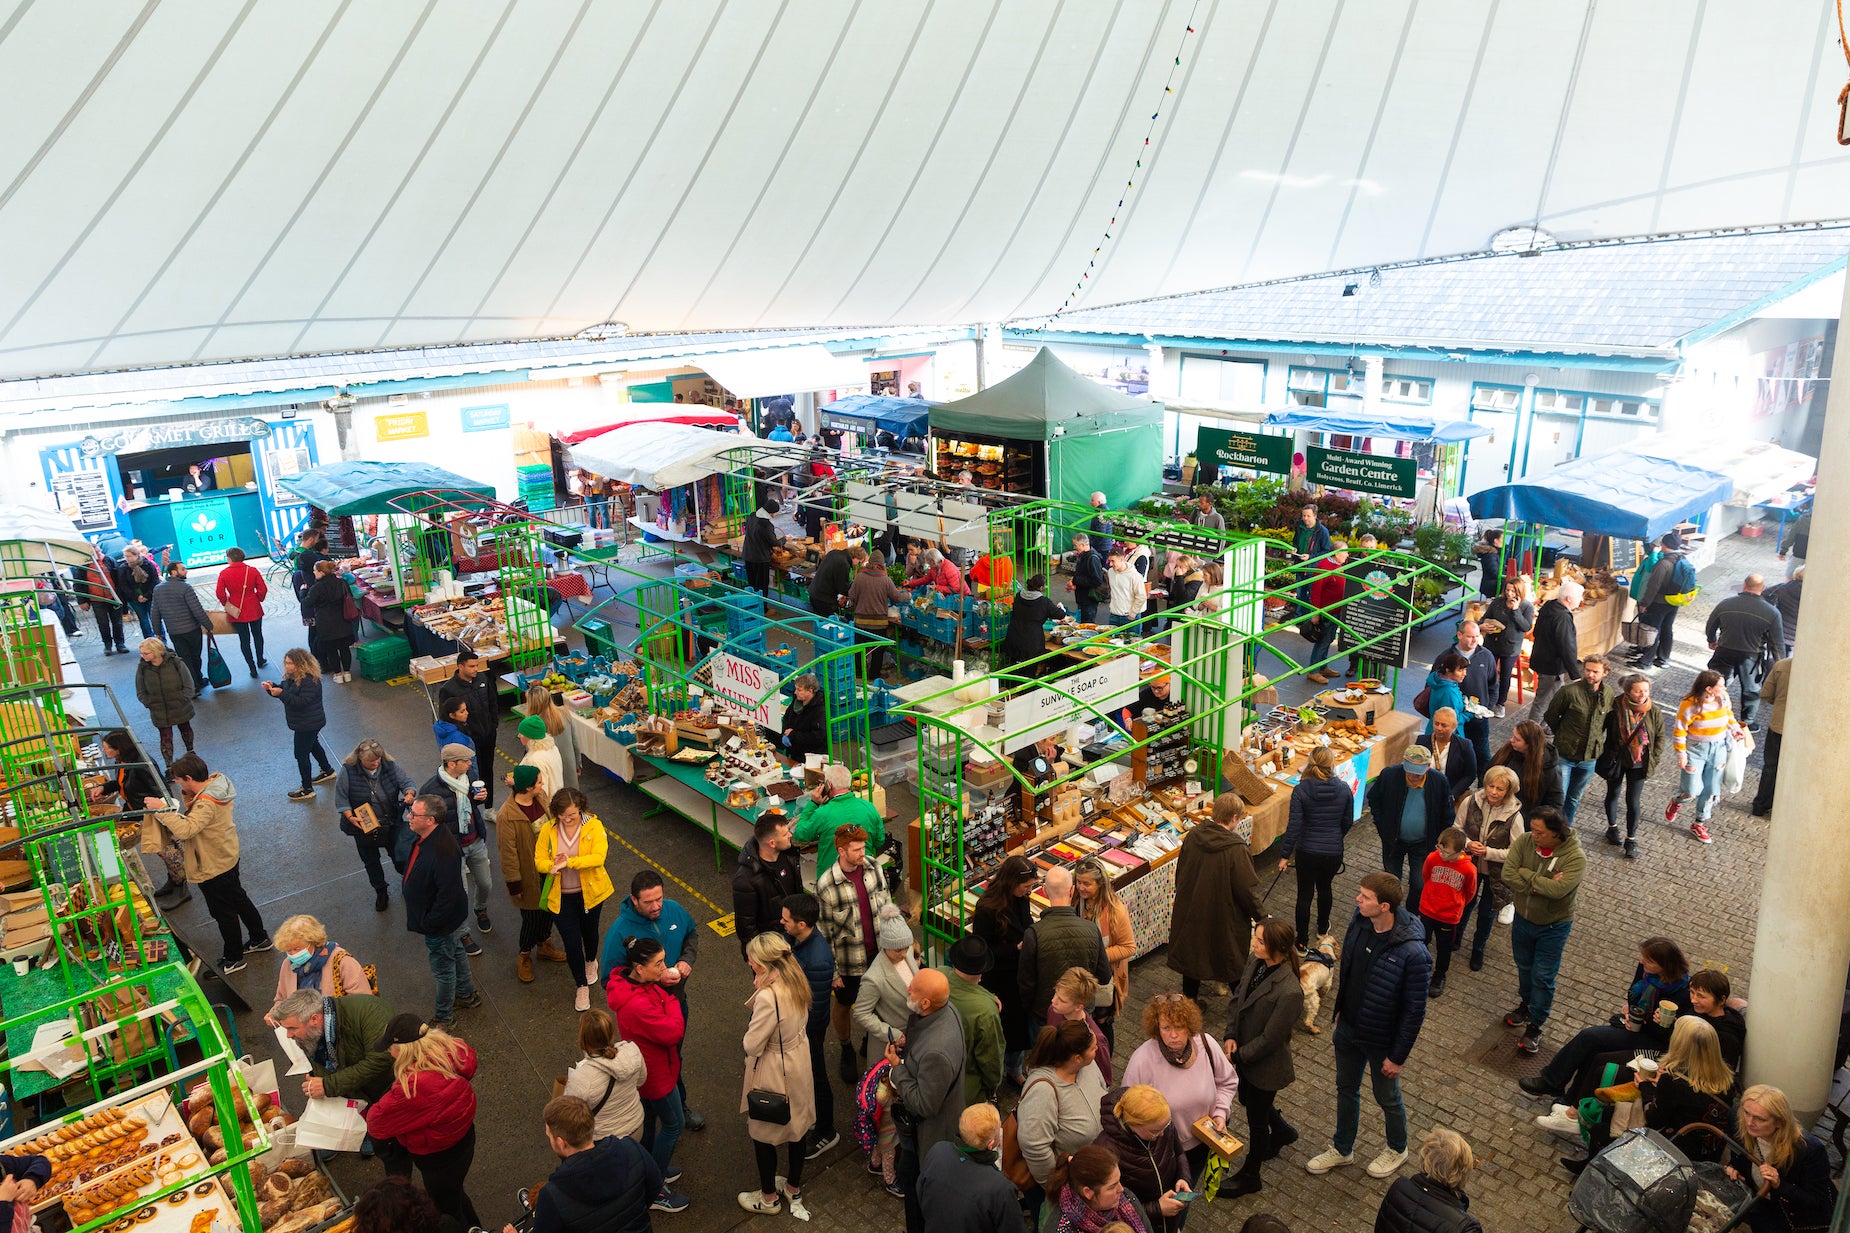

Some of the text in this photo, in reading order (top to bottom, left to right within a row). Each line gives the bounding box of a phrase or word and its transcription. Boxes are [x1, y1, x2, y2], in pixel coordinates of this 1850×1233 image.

[387, 417, 414, 427] FRIDAY
[387, 425, 417, 435] MARKET
[100, 423, 250, 451] GOURMET GRILL
[1216, 449, 1269, 465] Rockbarton
[1365, 459, 1393, 470] Winning
[1321, 461, 1398, 482] Garden Centre
[1316, 472, 1345, 484] Holycross,
[1364, 480, 1374, 488] Co.
[1374, 482, 1403, 491] Limerick
[726, 658, 761, 690] MISS
[1071, 677, 1080, 685] THE
[1077, 678, 1097, 694] SOAP
[715, 683, 769, 725] MUFFIN
